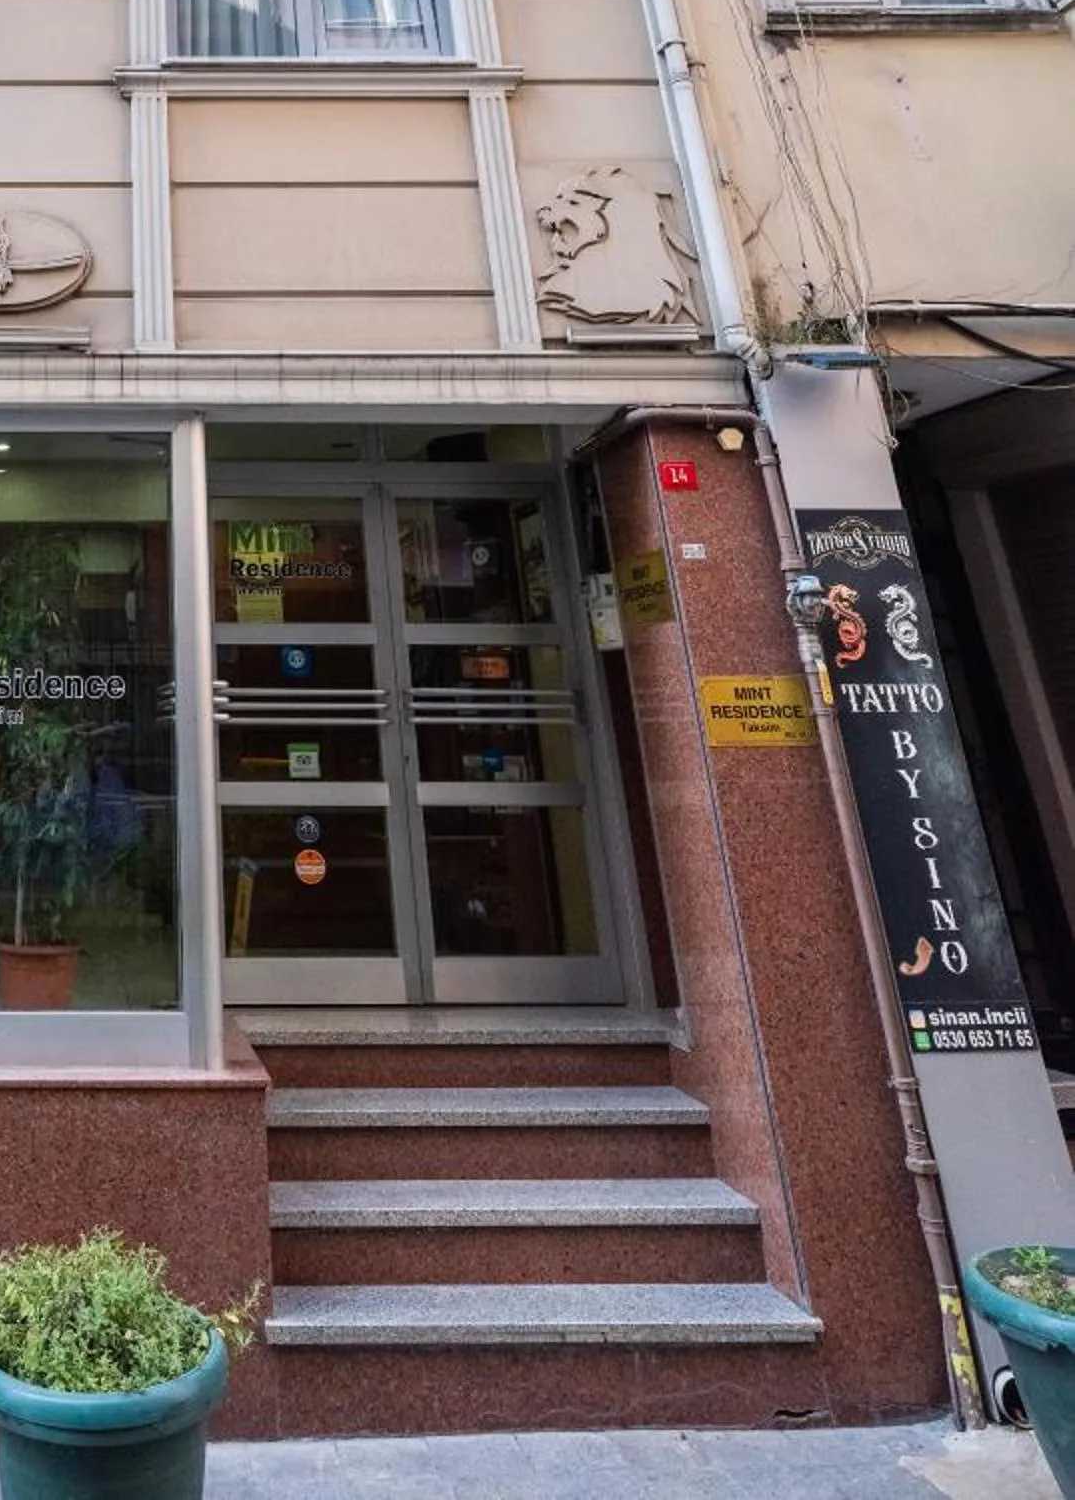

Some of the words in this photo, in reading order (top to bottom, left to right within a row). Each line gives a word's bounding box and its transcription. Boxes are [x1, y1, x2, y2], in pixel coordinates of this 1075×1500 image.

[669, 467, 688, 484] 14
[734, 686, 773, 701] MINT
[841, 683, 945, 714] TATTO
[710, 705, 806, 720] RESIDENCE
[932, 1030, 967, 1049] 0530
[968, 1029, 994, 1048] 653
[994, 1029, 1013, 1048] 71
[1015, 1029, 1034, 1048] 65
